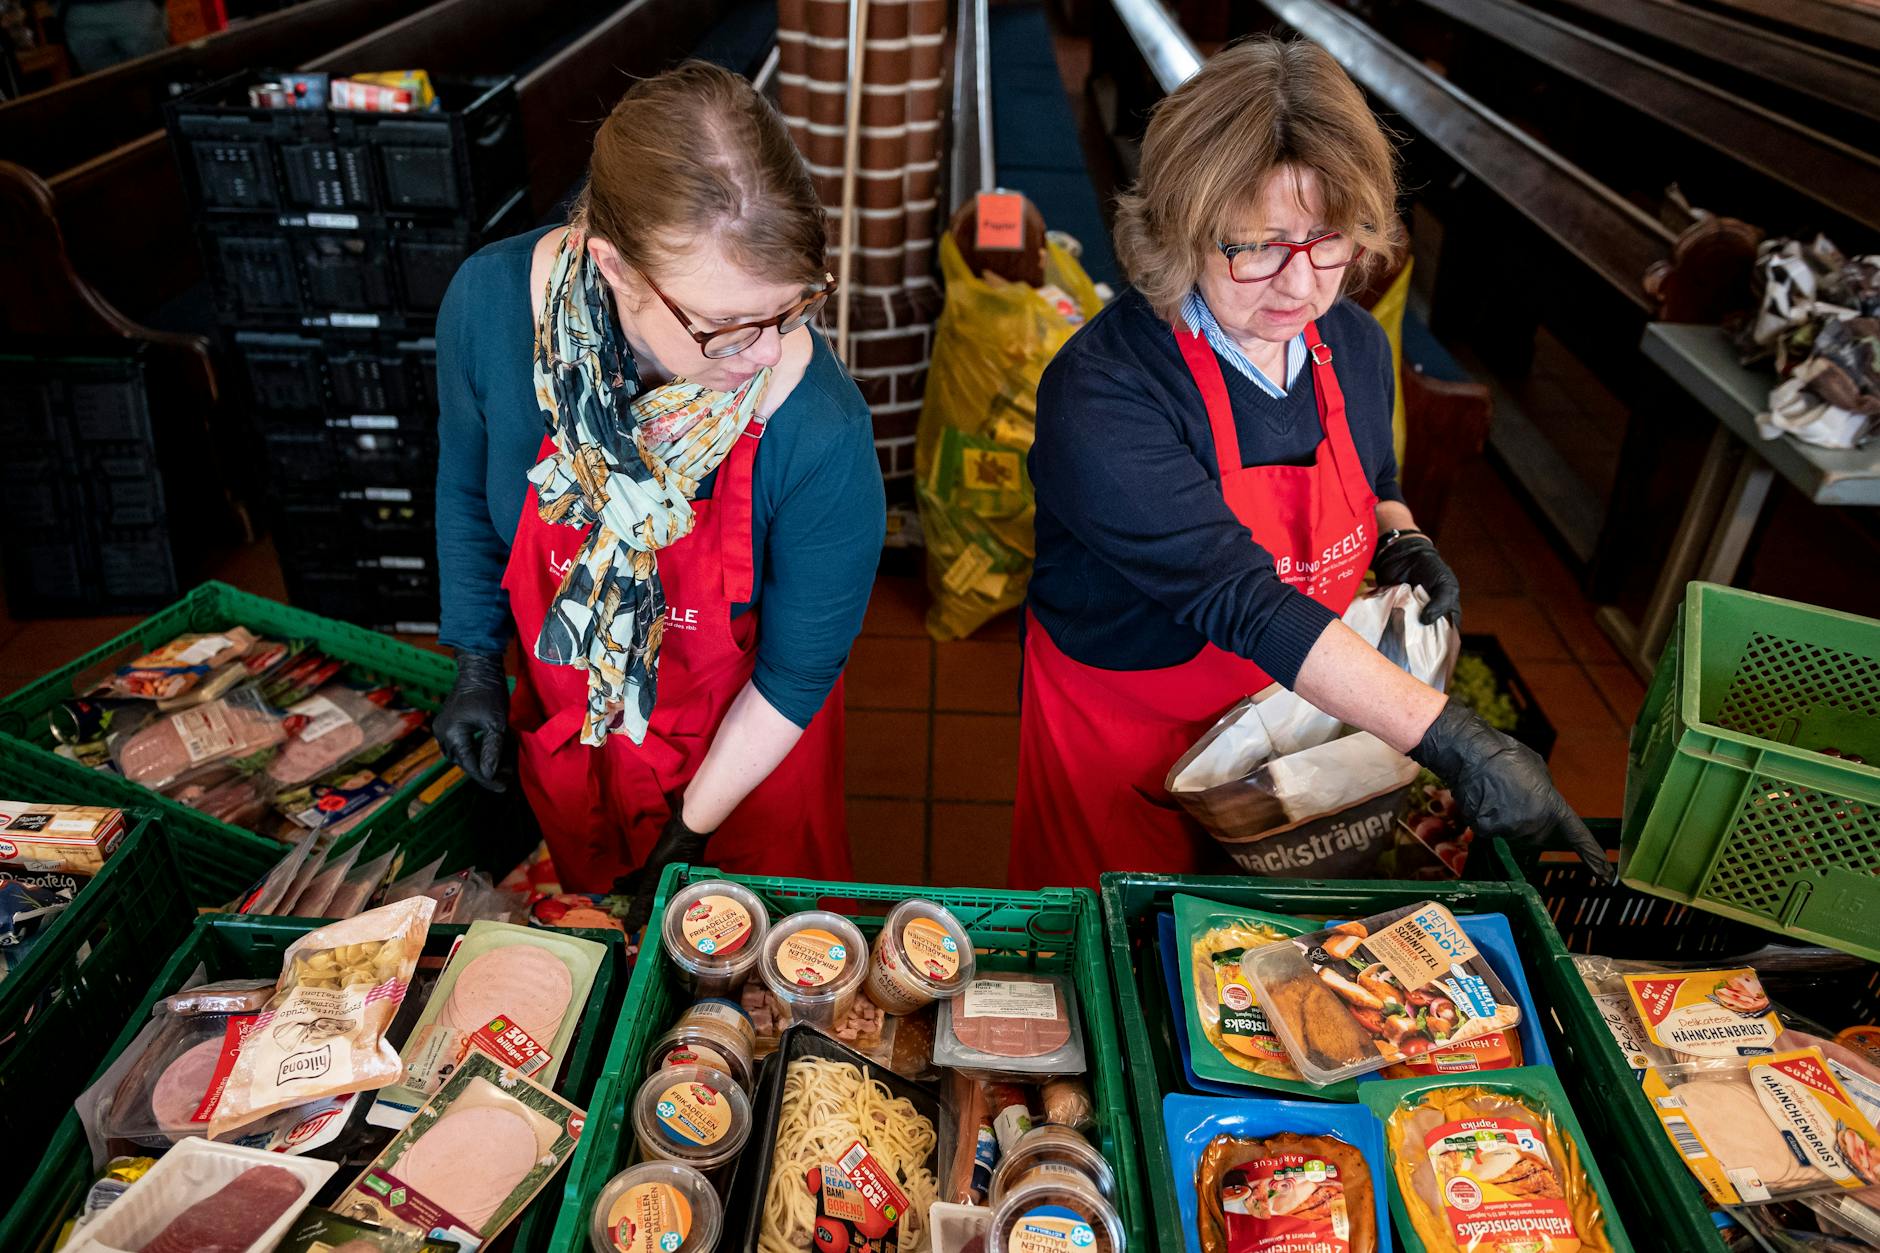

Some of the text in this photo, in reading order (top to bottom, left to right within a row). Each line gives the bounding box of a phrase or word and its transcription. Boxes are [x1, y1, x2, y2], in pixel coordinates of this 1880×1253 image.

[1276, 524, 1366, 575] IB UND SEELE
[551, 550, 572, 571] LA
[689, 911, 737, 939] FRIKADELLEN
[1404, 920, 1427, 940] MINI
[1425, 909, 1471, 950] PENNY
[1415, 915, 1462, 958] READY
[698, 943, 715, 952] GO
[912, 939, 956, 964] FRIKADELLEN
[1395, 926, 1439, 971] SCHNITZEL
[788, 949, 839, 971] FRIKADELLEN
[1478, 982, 1498, 1009] HEAT
[1641, 983, 1654, 999] GUT
[280, 1006, 309, 1017] Crudo
[1678, 1015, 1733, 1028] Delikatess
[1224, 1018, 1270, 1033] nsteaks
[1605, 1013, 1641, 1054] Beste
[1672, 1024, 1768, 1043] HÄHNCHENBRUST
[496, 1036, 526, 1064] billiger.
[504, 1026, 540, 1058] 30%
[1447, 1038, 1501, 1052] 2 Hähnch
[282, 1054, 328, 1076] hilcona
[1799, 1060, 1823, 1076] GUT
[1806, 1070, 1815, 1079] &
[198, 1076, 229, 1120] Bierschinken
[658, 1102, 671, 1117] GO
[670, 1091, 718, 1130] FRIKADELLEN
[1460, 1119, 1498, 1130] Paprika
[1761, 1075, 1840, 1170] HÄHNCHENBRUST
[827, 1187, 845, 1199] BAMI
[850, 1170, 883, 1208] 30%
[827, 1199, 863, 1216] GORENG
[1457, 1217, 1571, 1236] Hähnchensteaks
[666, 1232, 679, 1252] GO
